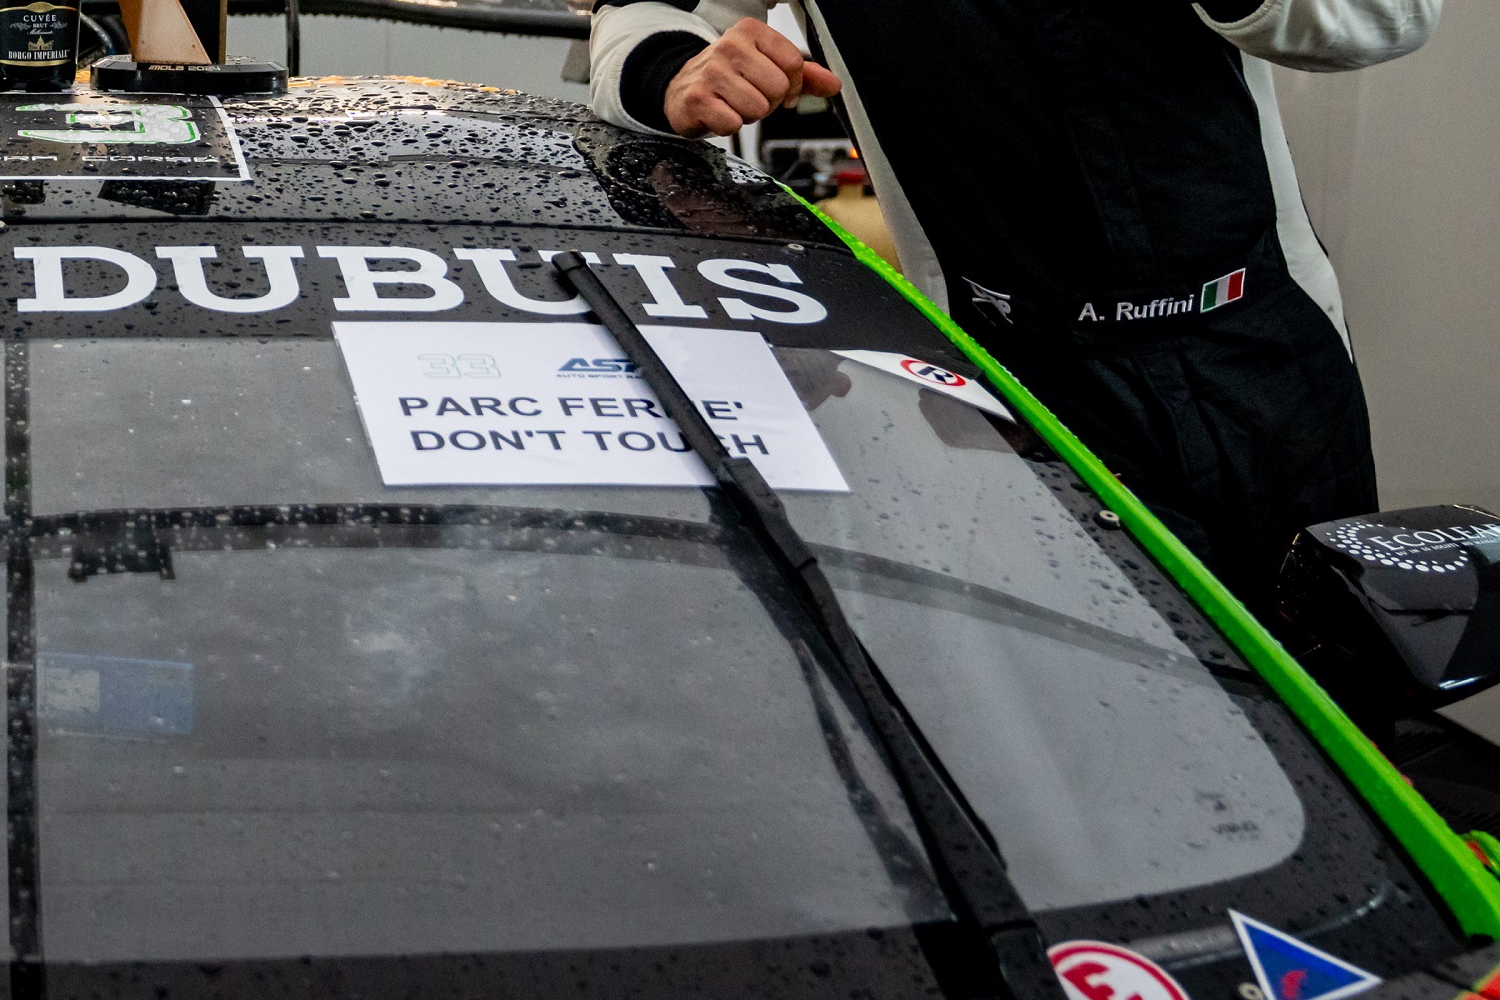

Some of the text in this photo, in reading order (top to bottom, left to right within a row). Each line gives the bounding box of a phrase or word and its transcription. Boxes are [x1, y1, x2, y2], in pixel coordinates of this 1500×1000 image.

[8, 50, 68, 60] BORGO IMPERIALE
[13, 245, 829, 323] DUBUIS
[1078, 294, 1195, 321] A. Ruffini
[417, 354, 502, 379] 33
[398, 396, 743, 421] PARC FERE'
[409, 430, 566, 451] DON'T
